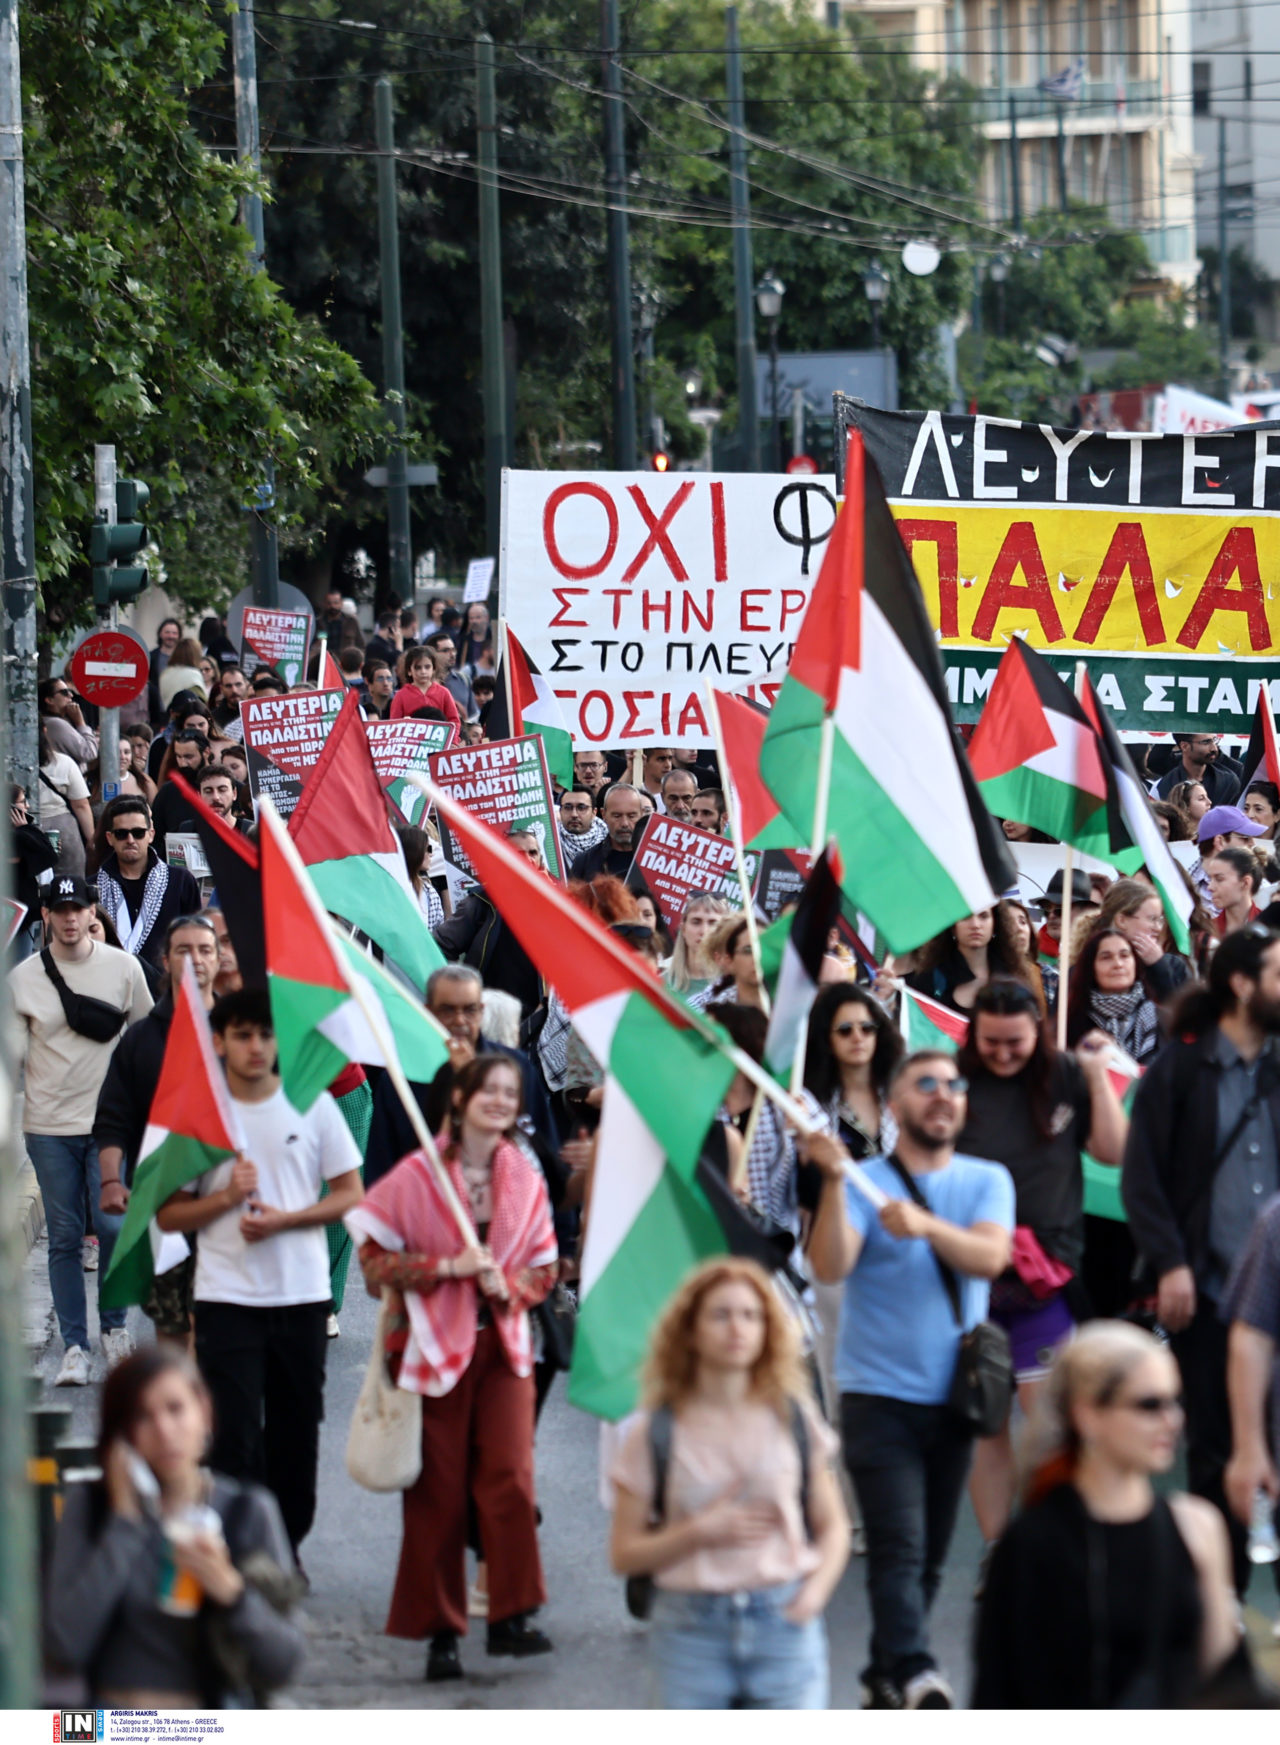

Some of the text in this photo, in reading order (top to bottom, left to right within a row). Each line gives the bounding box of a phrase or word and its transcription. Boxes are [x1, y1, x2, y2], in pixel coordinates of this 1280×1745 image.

[543, 481, 729, 583] ΟΧΙ
[247, 612, 306, 629] ΛΕΥΤΕΡΙΑ
[548, 588, 715, 633] ΣΤΗΝ
[245, 628, 305, 644] ΠΑΛΑΙΣΤΙΝΗ
[550, 639, 644, 672] ΣΤΟ
[248, 693, 342, 723] ΛΕΥΤΕΡΙΑ
[283, 716, 306, 726] ΣΤΗΝ
[366, 722, 445, 742] ΛΕΥΤΕΡΙΑ
[437, 741, 538, 776] ΛΕΥΤΕΡΙΑ
[475, 768, 500, 779] ΣΤΗΝ
[440, 769, 542, 801] ΠΑΛΑΙΣΤΙΝΗ
[494, 789, 544, 809] ΙΟΡΔΑΝΗ
[498, 803, 546, 822] ΜΕΣΟΓΕΙΟ
[683, 854, 710, 870] ΣΤΗΝ
[640, 850, 744, 902] ΠΑΛΑΙΣΤΙΝΗ
